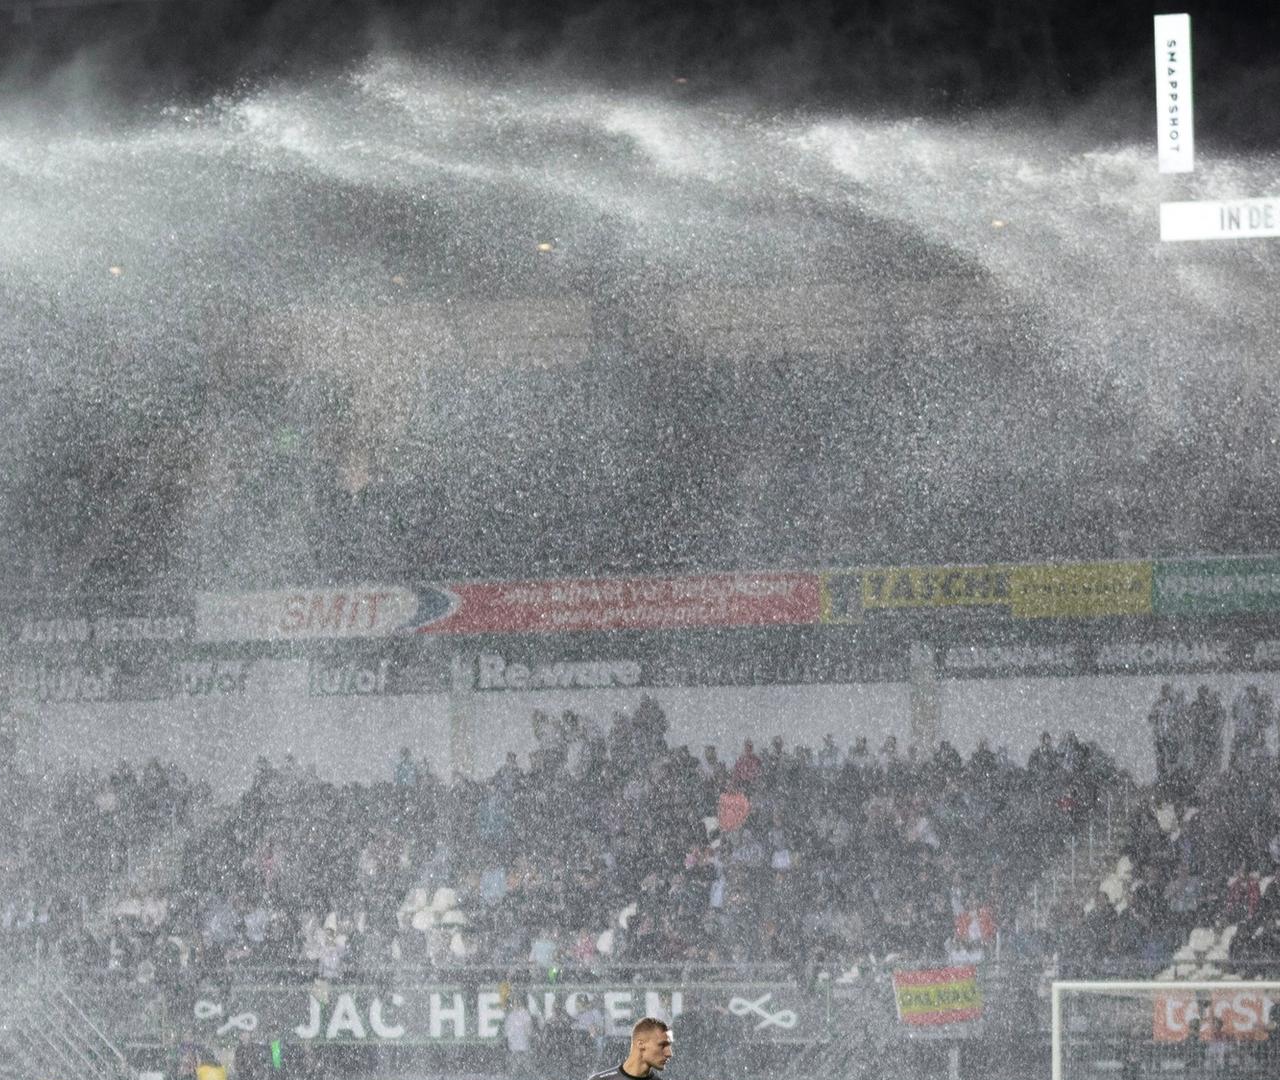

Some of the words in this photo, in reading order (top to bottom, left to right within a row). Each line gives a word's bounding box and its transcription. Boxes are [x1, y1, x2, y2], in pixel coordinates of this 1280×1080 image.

[1219, 206, 1242, 232] IN
[1247, 203, 1275, 230] DE
[296, 993, 405, 1039] JAC
